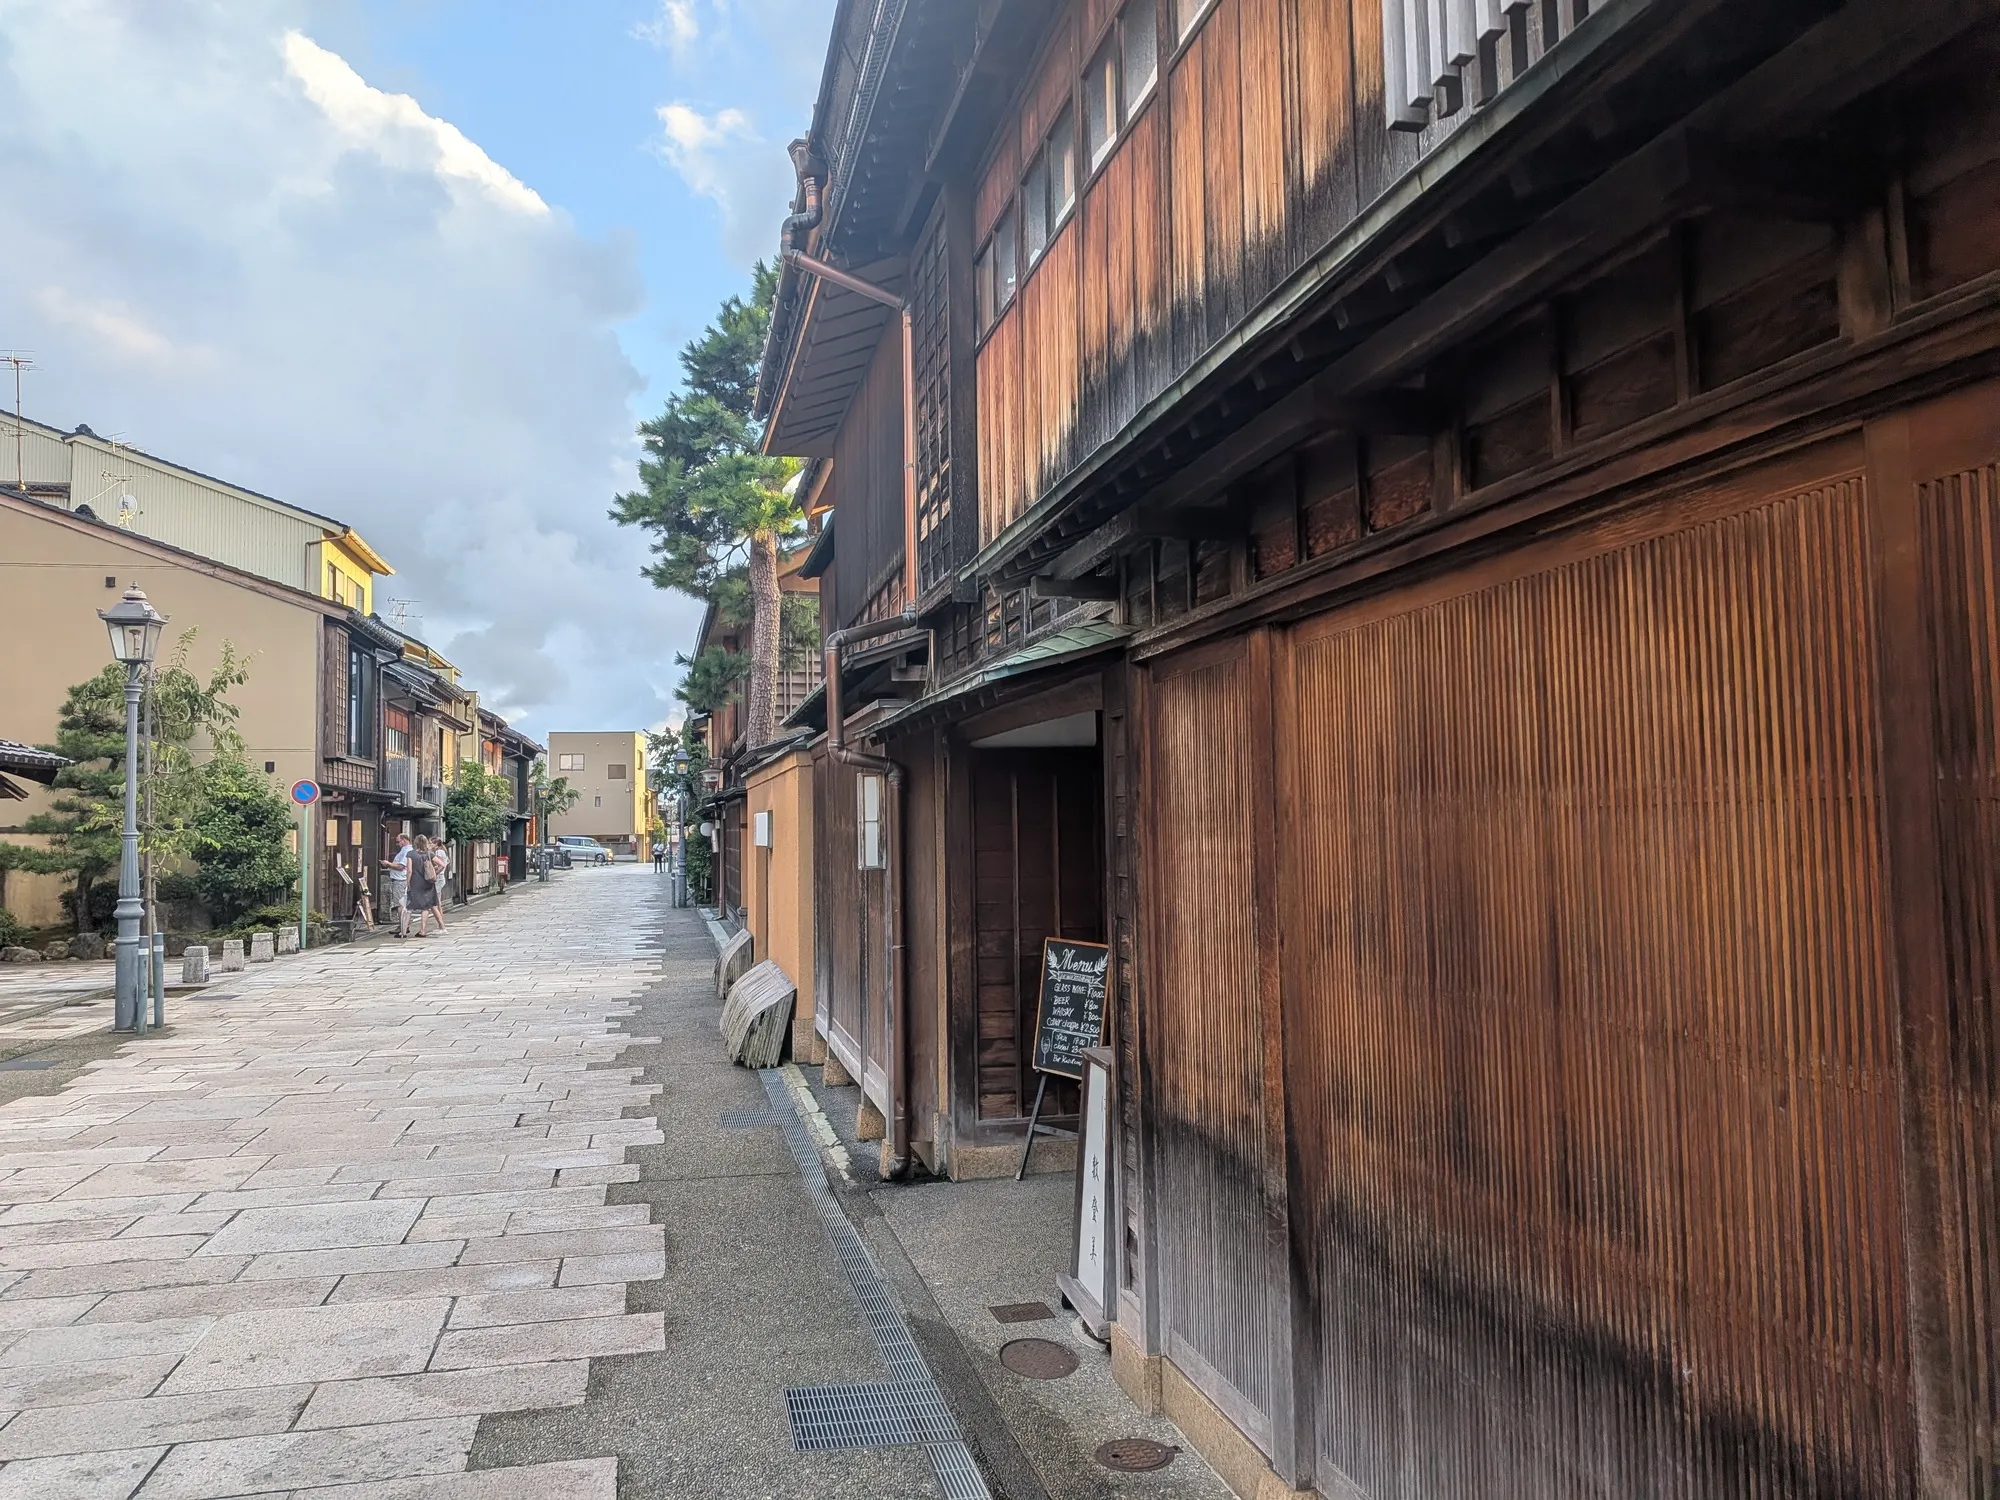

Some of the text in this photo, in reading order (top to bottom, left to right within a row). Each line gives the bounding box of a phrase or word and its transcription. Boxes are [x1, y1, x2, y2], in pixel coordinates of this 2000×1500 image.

[1058, 948, 1094, 973] Menu
[1054, 983, 1071, 993] GLASS
[1072, 985, 1087, 994] WINE
[1053, 995, 1070, 1005] BEER
